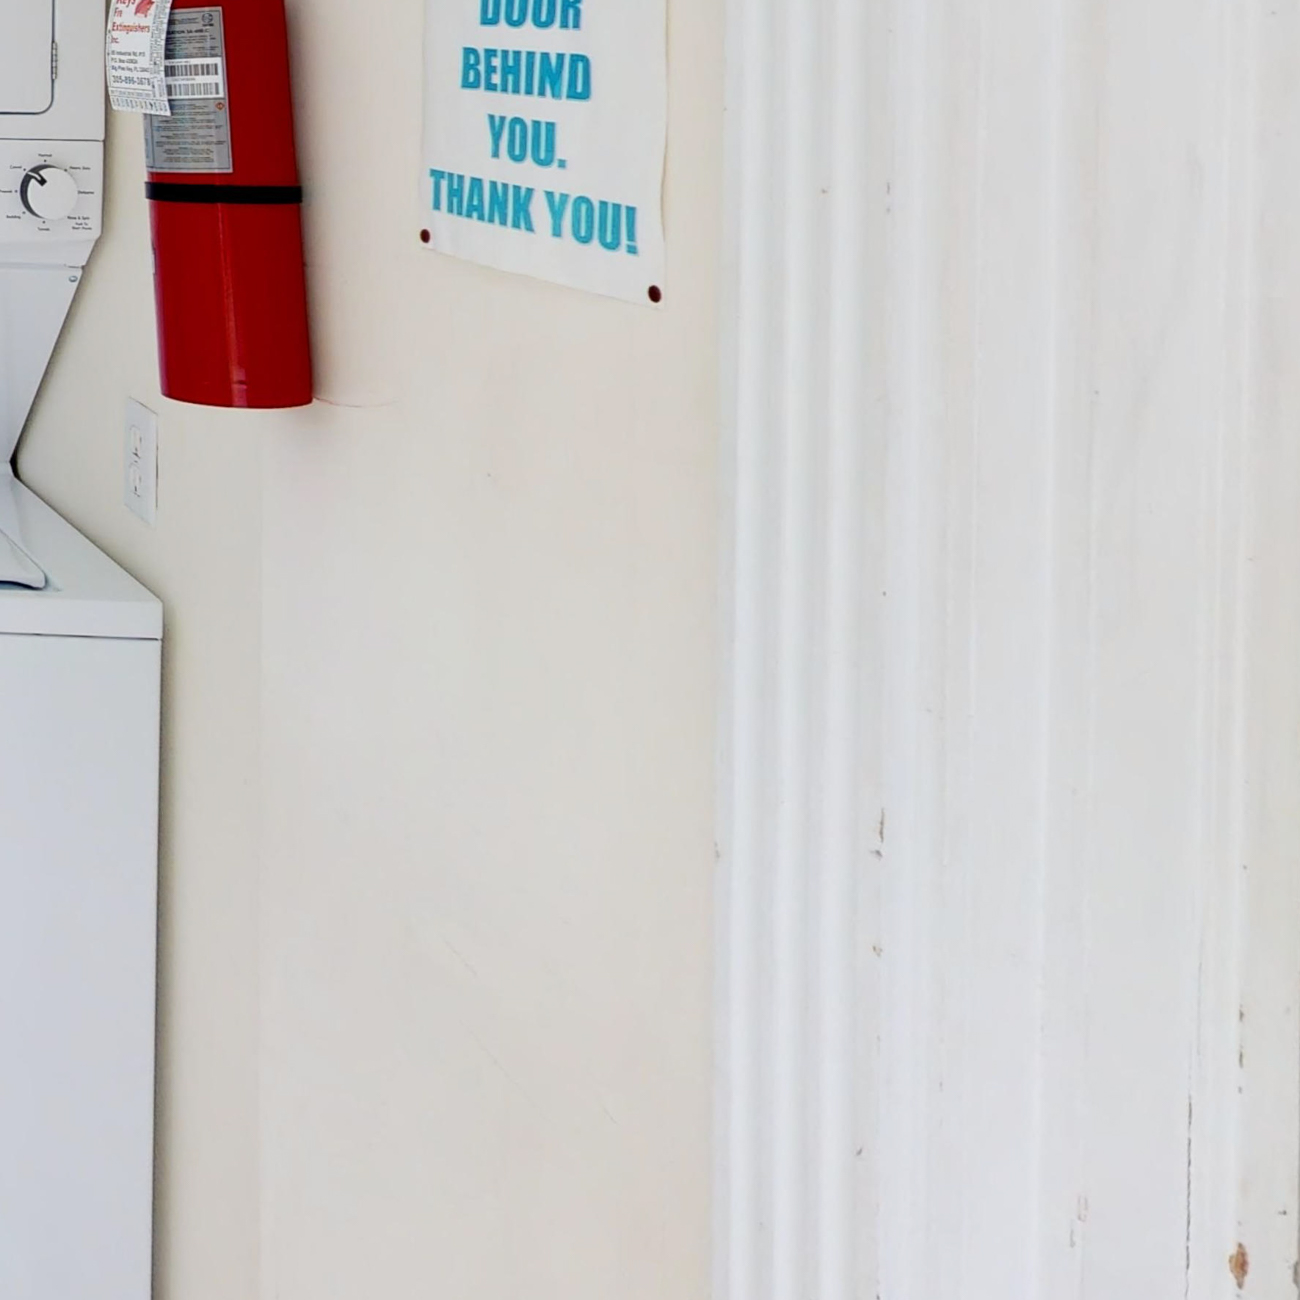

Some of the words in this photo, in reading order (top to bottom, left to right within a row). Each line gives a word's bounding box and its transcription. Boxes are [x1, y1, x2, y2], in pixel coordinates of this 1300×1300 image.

[112, 22, 150, 34] Extinguishers
[460, 46, 592, 102] BEHIND
[488, 113, 566, 169] YOU.
[429, 168, 535, 234] THANK
[544, 189, 639, 256] YOU!
